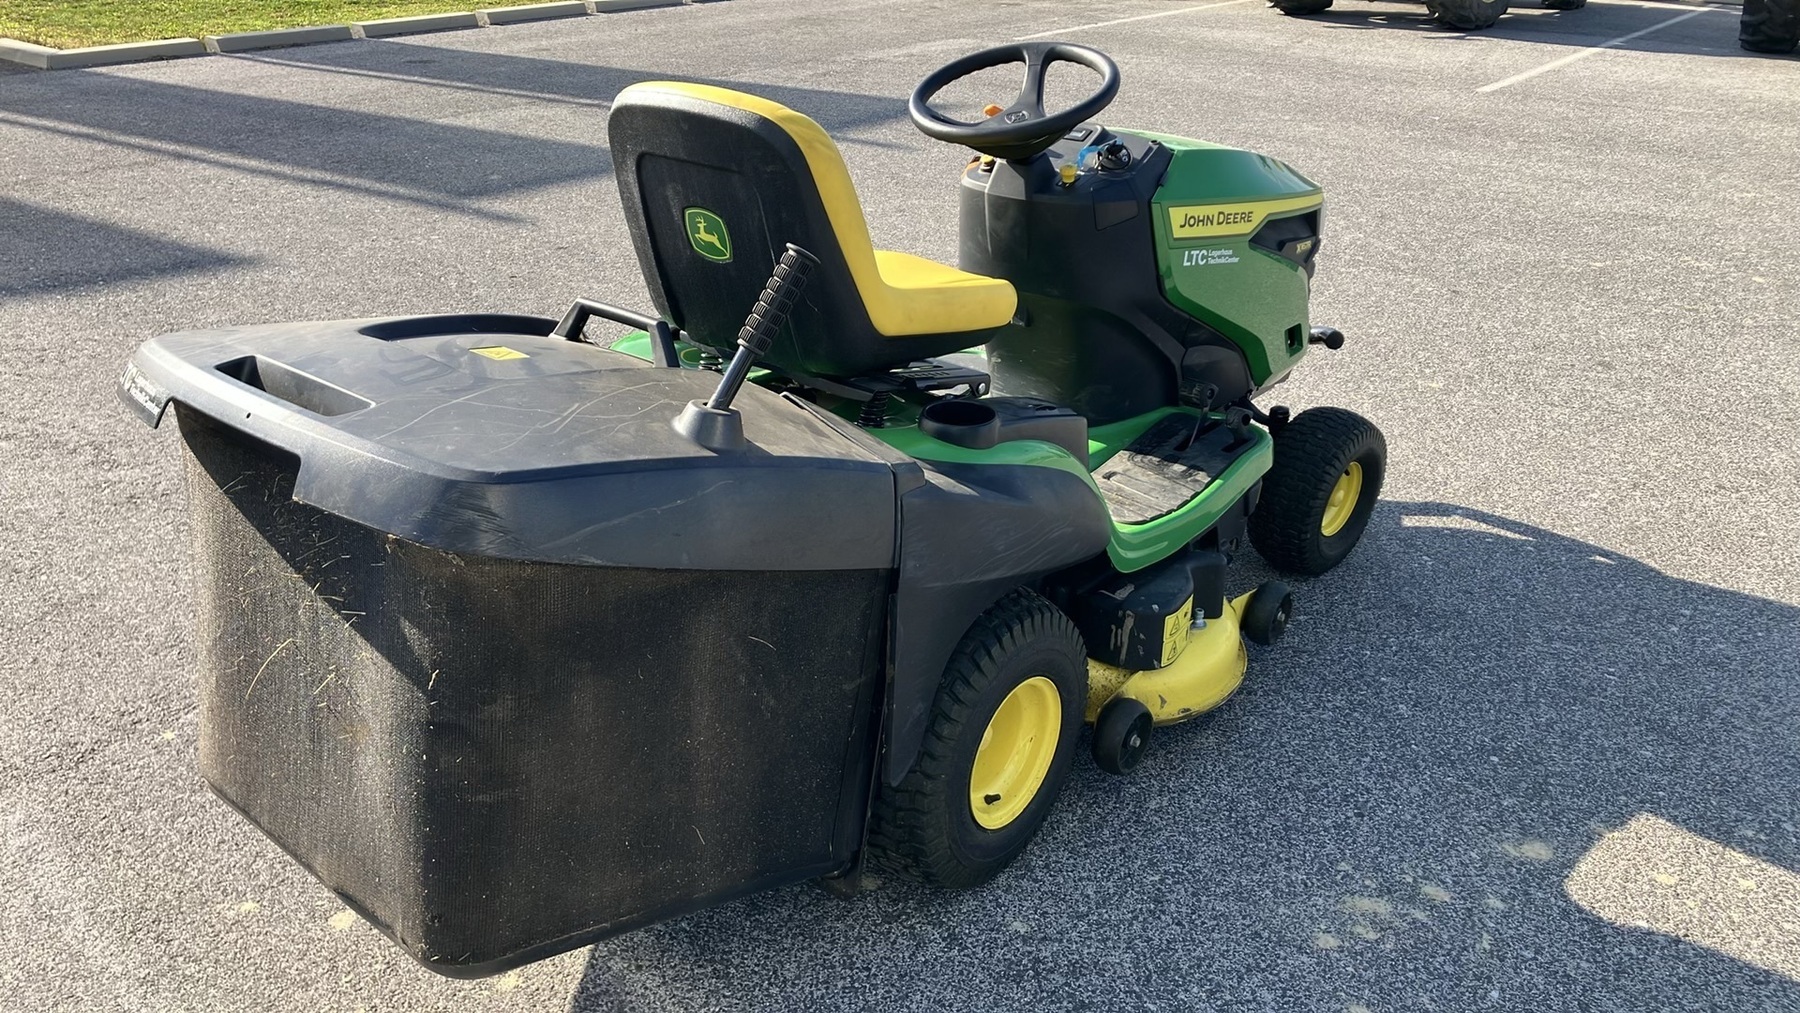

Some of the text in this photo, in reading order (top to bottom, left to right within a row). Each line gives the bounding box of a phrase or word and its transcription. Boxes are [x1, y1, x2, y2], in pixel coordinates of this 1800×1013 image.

[1180, 211, 1254, 228] JOHN DEERE
[1183, 250, 1207, 266] LTC
